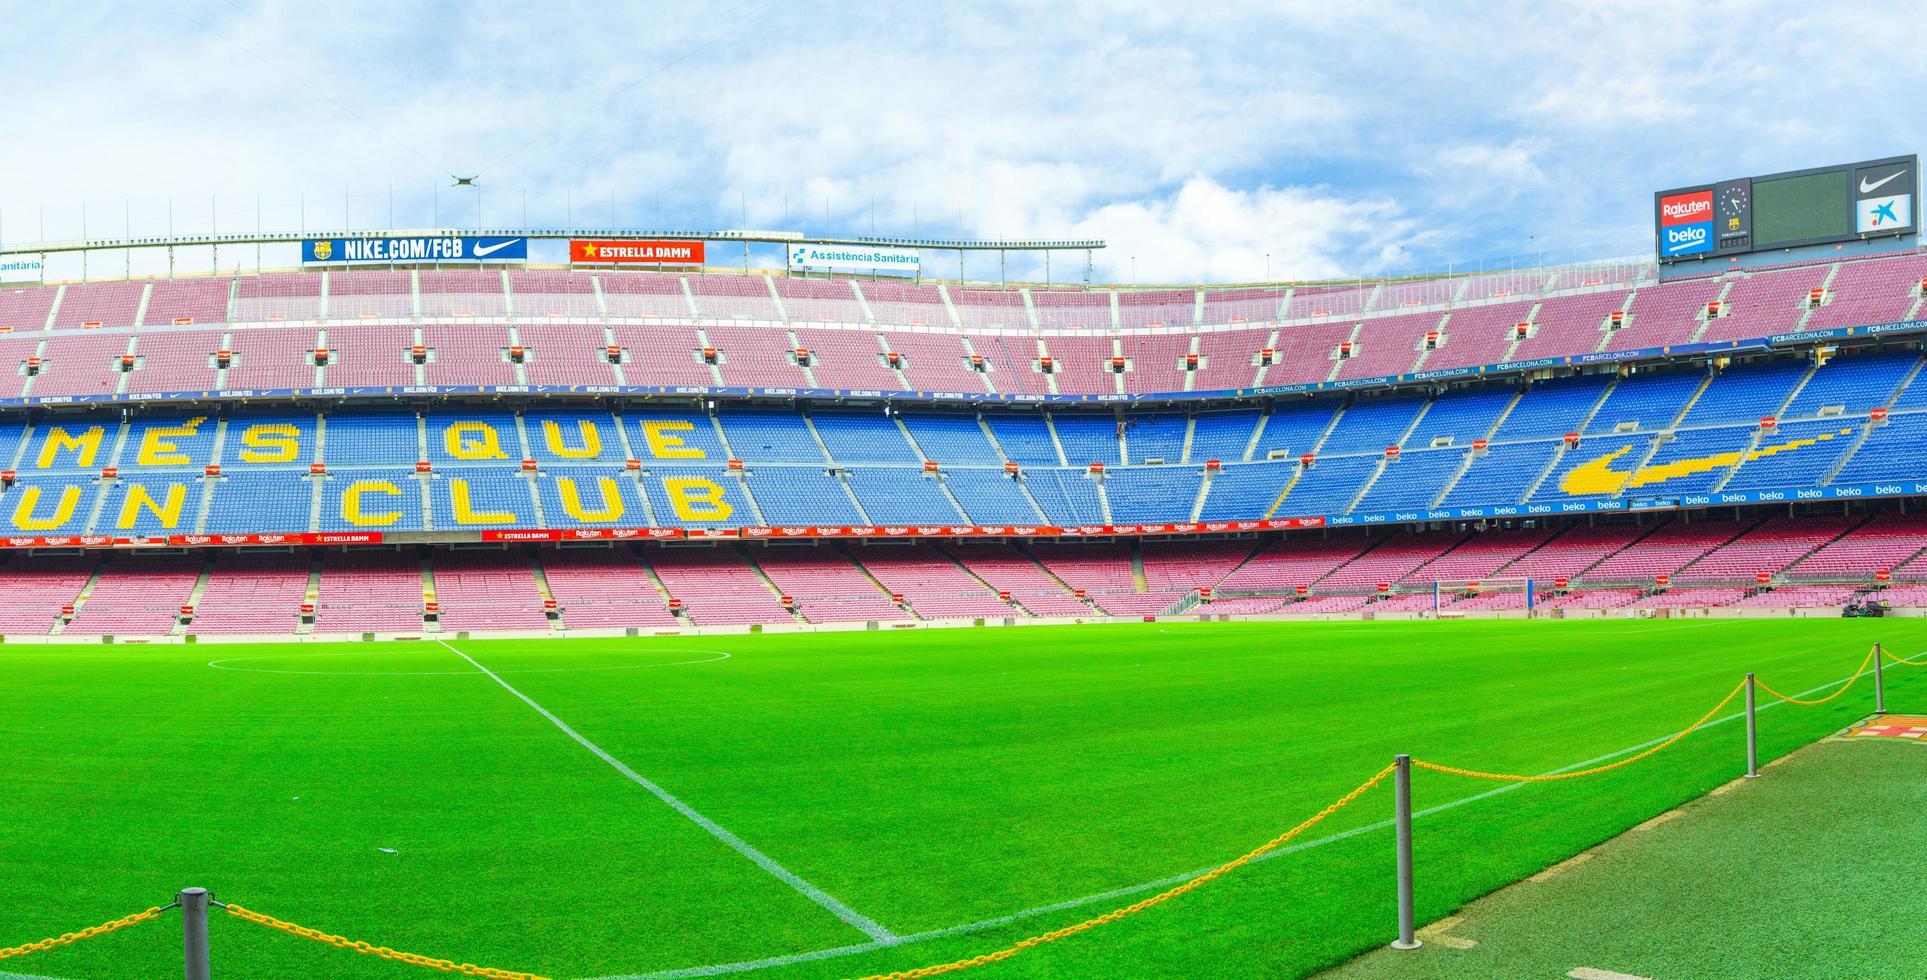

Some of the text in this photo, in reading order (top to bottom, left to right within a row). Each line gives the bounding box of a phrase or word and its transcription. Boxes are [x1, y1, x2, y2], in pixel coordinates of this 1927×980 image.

[1663, 200, 1710, 218] Rakuten
[1668, 227, 1706, 243] beko
[344, 239, 463, 259] NIKE.COM/FCB
[599, 247, 691, 258] ESTRELLA DAMM
[810, 250, 919, 264] Assistència Sanitària
[1772, 330, 1833, 342] FCBARCELONA.COM
[1583, 351, 1639, 362] FCBARCELONA.COM
[1496, 359, 1553, 370] FCBARCELONA.COM
[1414, 368, 1468, 380] FCBARCELONA.COM
[1334, 377, 1387, 388] FCBARCELONA.COM
[1254, 384, 1306, 393] FCBARCELONA.COM
[38, 417, 705, 468] MÉS QUE
[1798, 490, 1822, 498] beko
[1837, 488, 1861, 496] beko
[1876, 486, 1901, 494] beko
[1686, 496, 1709, 504] beko
[1723, 494, 1746, 502] beko
[1760, 492, 1783, 500] beko
[13, 479, 733, 530] UN CLUB
[1269, 520, 1290, 528] Rakuten
[1299, 518, 1320, 526] Rakuten
[852, 527, 875, 535] Rakuten
[885, 527, 908, 535] Rakuten
[918, 527, 941, 535] Rakuten
[1080, 526, 1103, 534] Rakuten
[1113, 525, 1136, 533] Rakuten
[1207, 523, 1228, 531] Rakuten
[576, 530, 601, 538] Rakuten
[613, 529, 638, 537] Rakuten
[649, 528, 674, 537] Rakuten
[186, 536, 210, 544] Rakuten
[222, 535, 247, 543] Rakuten
[259, 535, 285, 543] Rakuten
